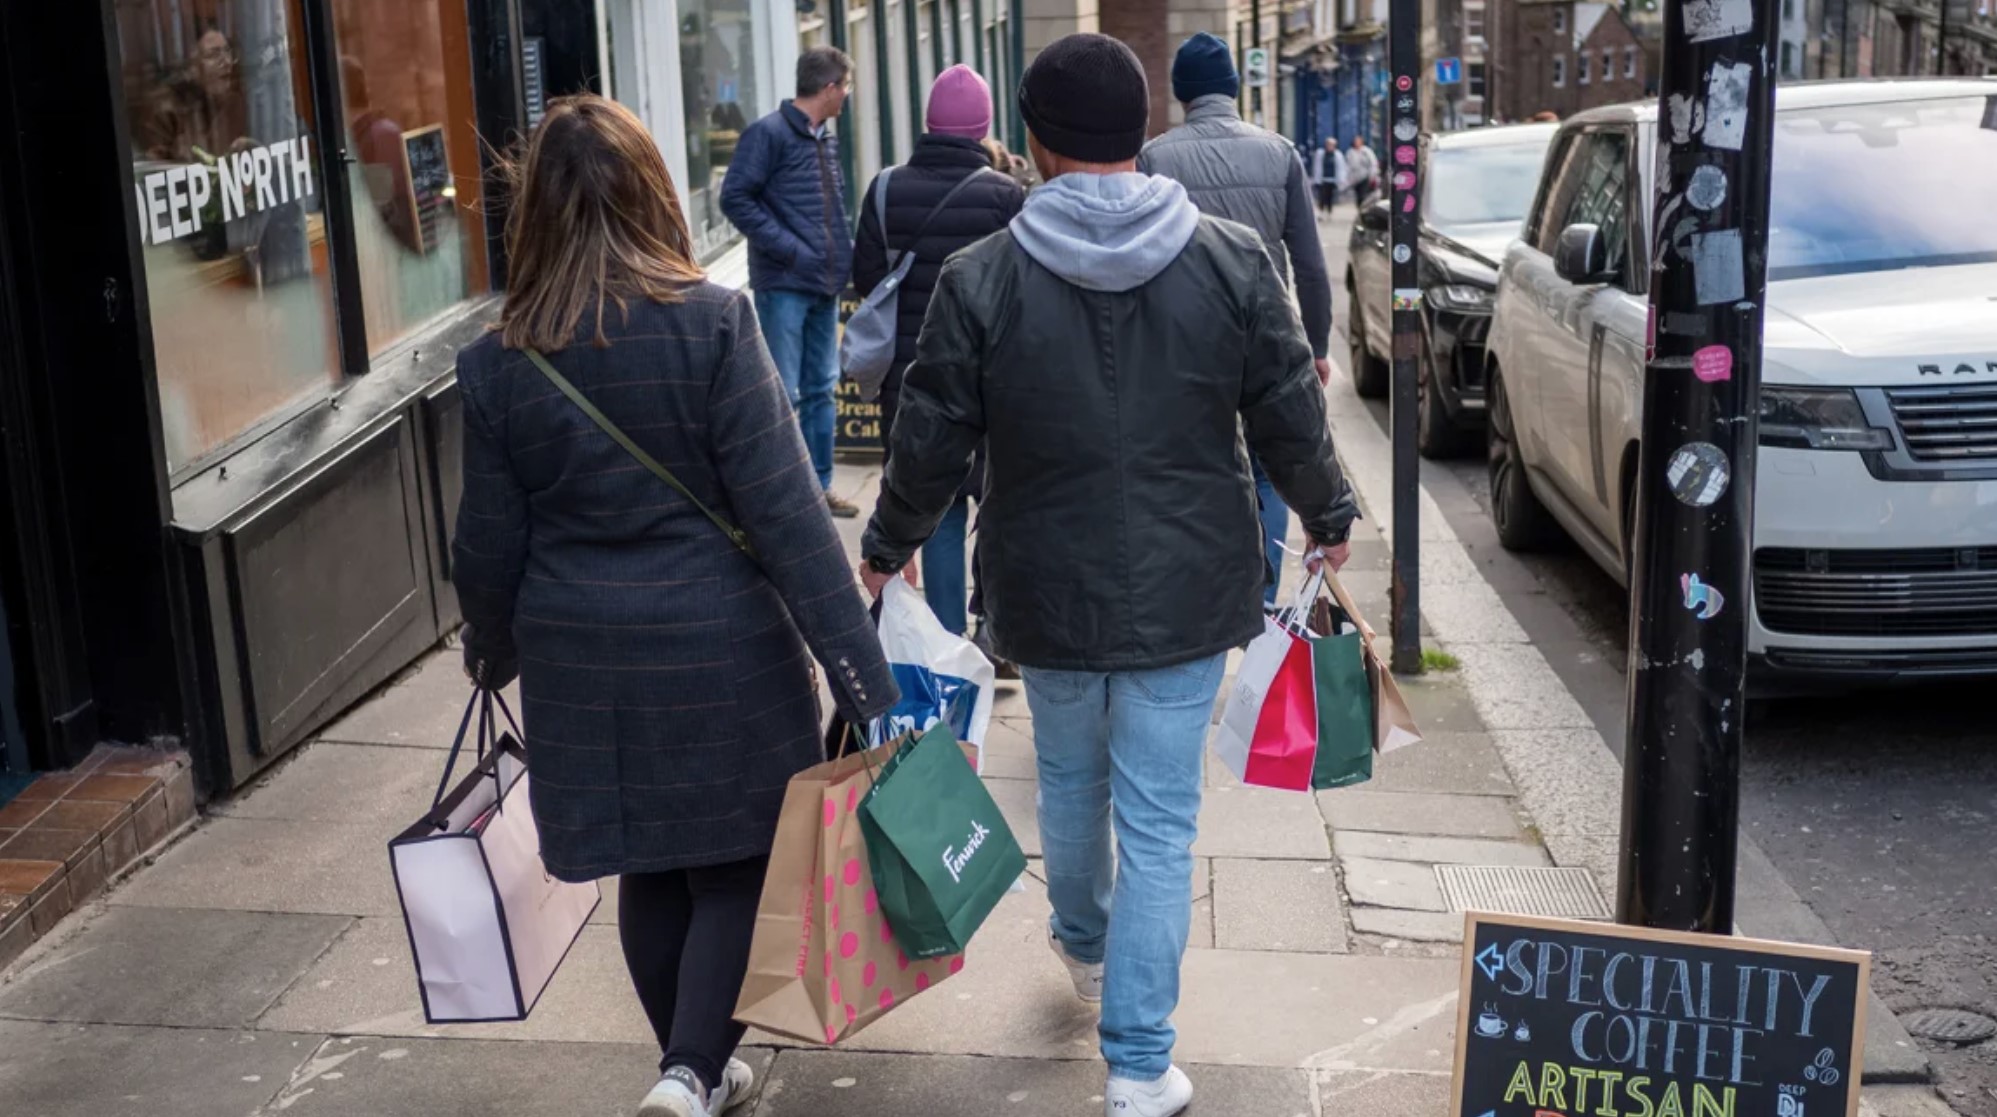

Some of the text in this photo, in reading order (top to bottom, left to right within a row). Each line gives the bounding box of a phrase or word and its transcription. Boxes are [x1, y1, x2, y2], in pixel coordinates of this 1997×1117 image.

[942, 819, 990, 884] Fenwick
[1501, 938, 1833, 1038] SPECIALITY
[1571, 1011, 1765, 1086] COFFEE
[1503, 1060, 1736, 1117] ARTISAN
[1778, 1082, 1807, 1096] DEEP
